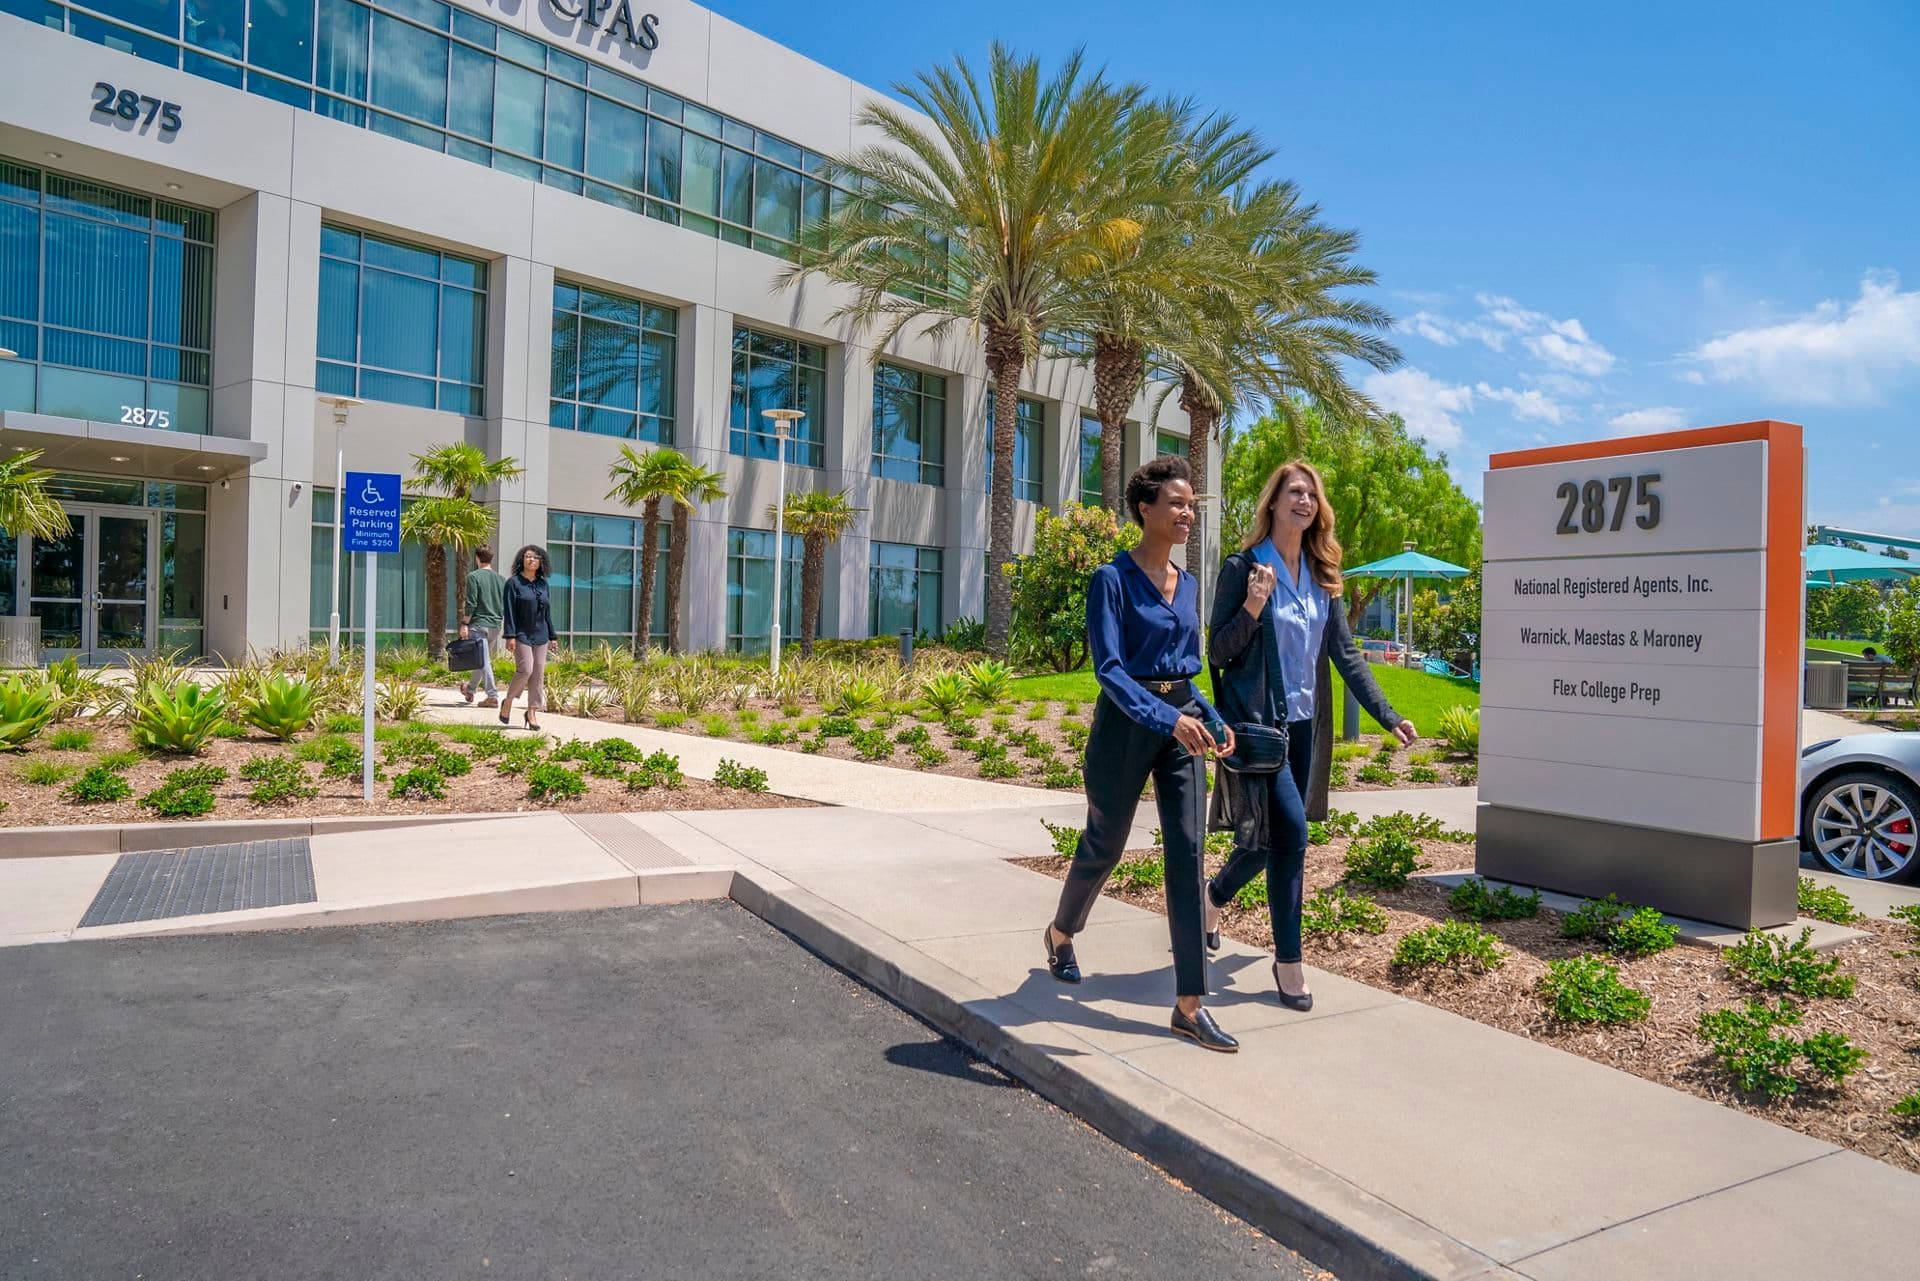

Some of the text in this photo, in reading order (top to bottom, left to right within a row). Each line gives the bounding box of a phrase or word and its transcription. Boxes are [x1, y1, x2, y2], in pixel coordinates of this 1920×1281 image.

[94, 81, 182, 132] 2875
[120, 405, 170, 428] 2875
[349, 506, 397, 517] Reserved
[1556, 473, 1661, 535] 2875
[352, 518, 393, 531] Parking
[355, 530, 390, 538] Minimum
[351, 538, 393, 547] Fine $250
[1514, 574, 1713, 599] National Registered Agents, Inc.
[1520, 627, 1702, 652] Warnick, Maestas & Maroney
[1553, 679, 1661, 705] Flex College Prep
